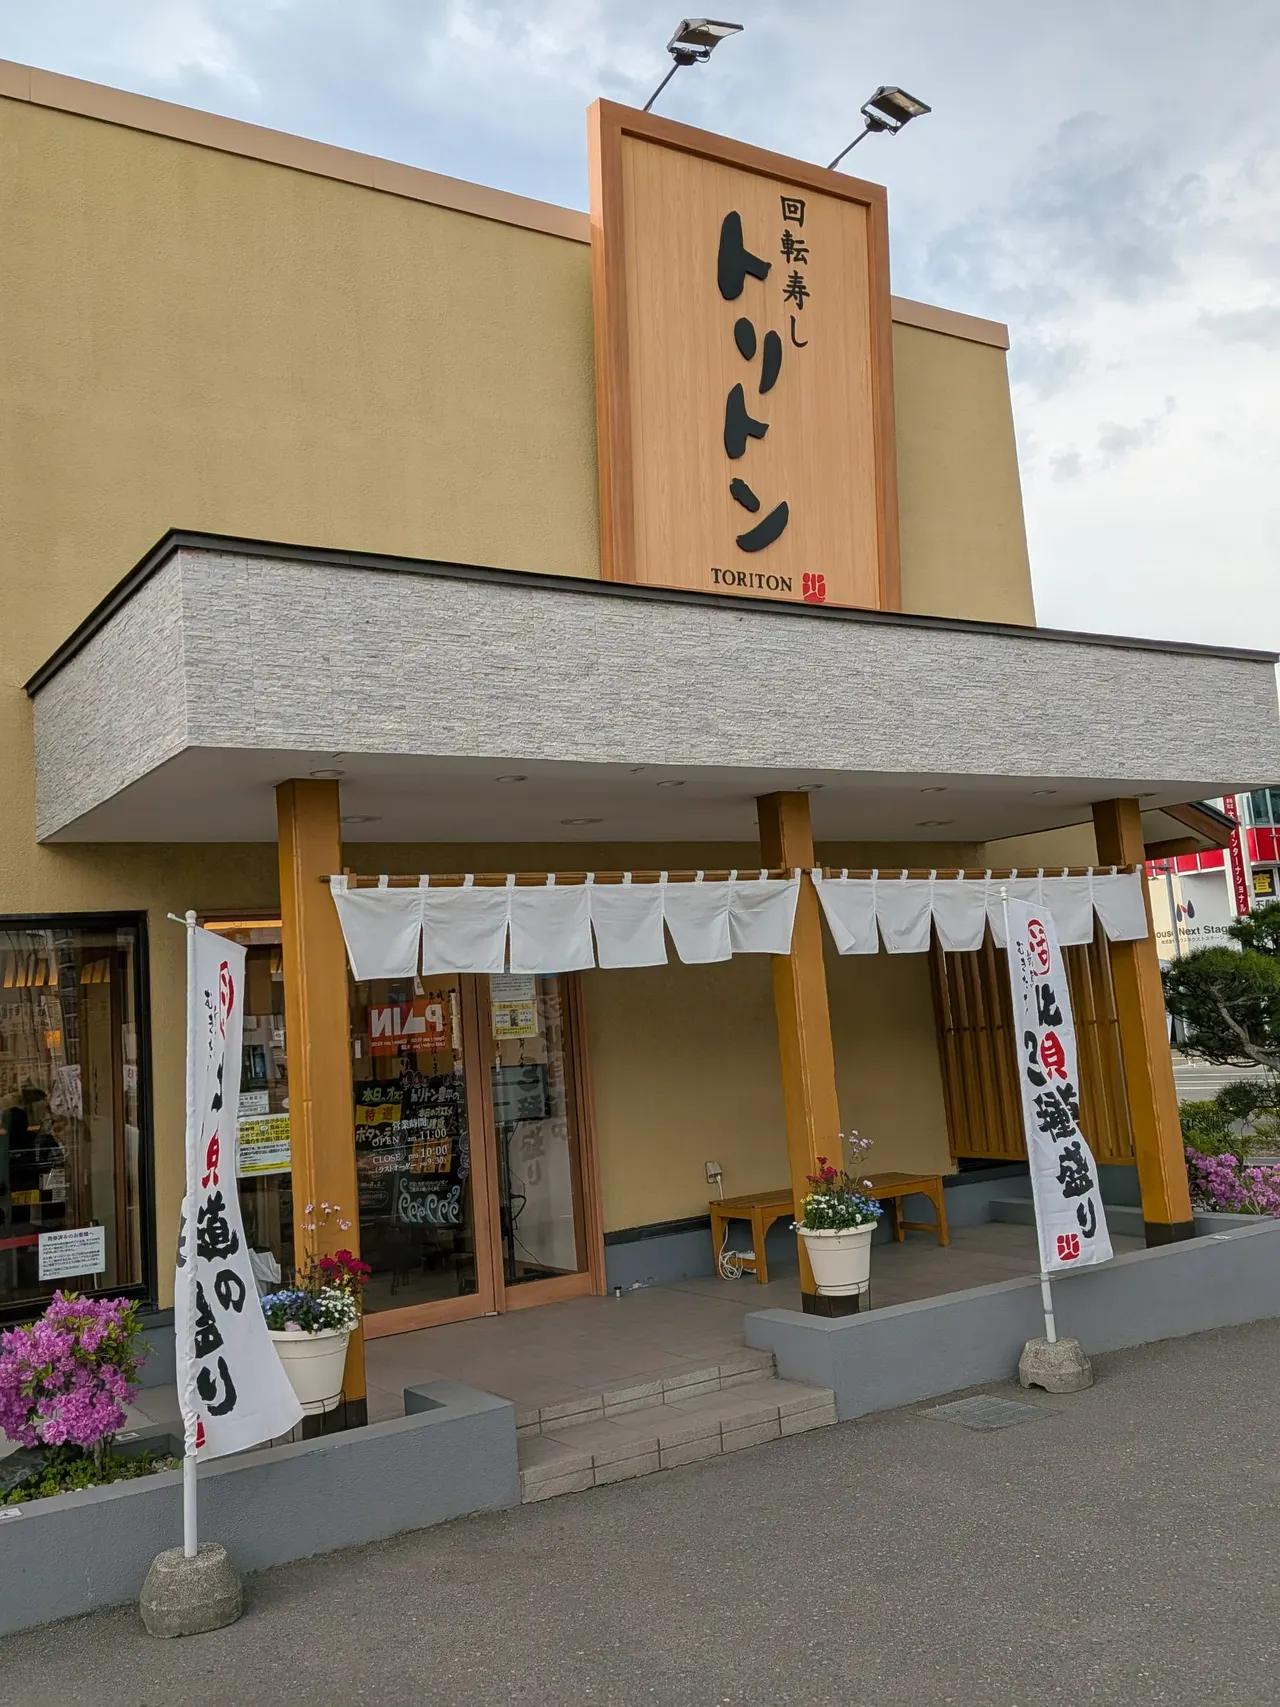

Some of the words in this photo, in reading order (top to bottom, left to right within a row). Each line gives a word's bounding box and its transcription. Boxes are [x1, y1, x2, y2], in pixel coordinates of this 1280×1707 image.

[780, 195, 811, 348] 回転寿し
[717, 210, 790, 553] トリトン
[711, 567, 793, 592] TORITON
[1156, 930, 1173, 939] ous
[1179, 926, 1200, 936] Next
[392, 1117, 428, 1132] 営業時間
[371, 1136, 400, 1147] OPEN
[419, 1128, 447, 1142] 11:00
[372, 1153, 401, 1165] CLOSE
[420, 1145, 448, 1159] 10:00
